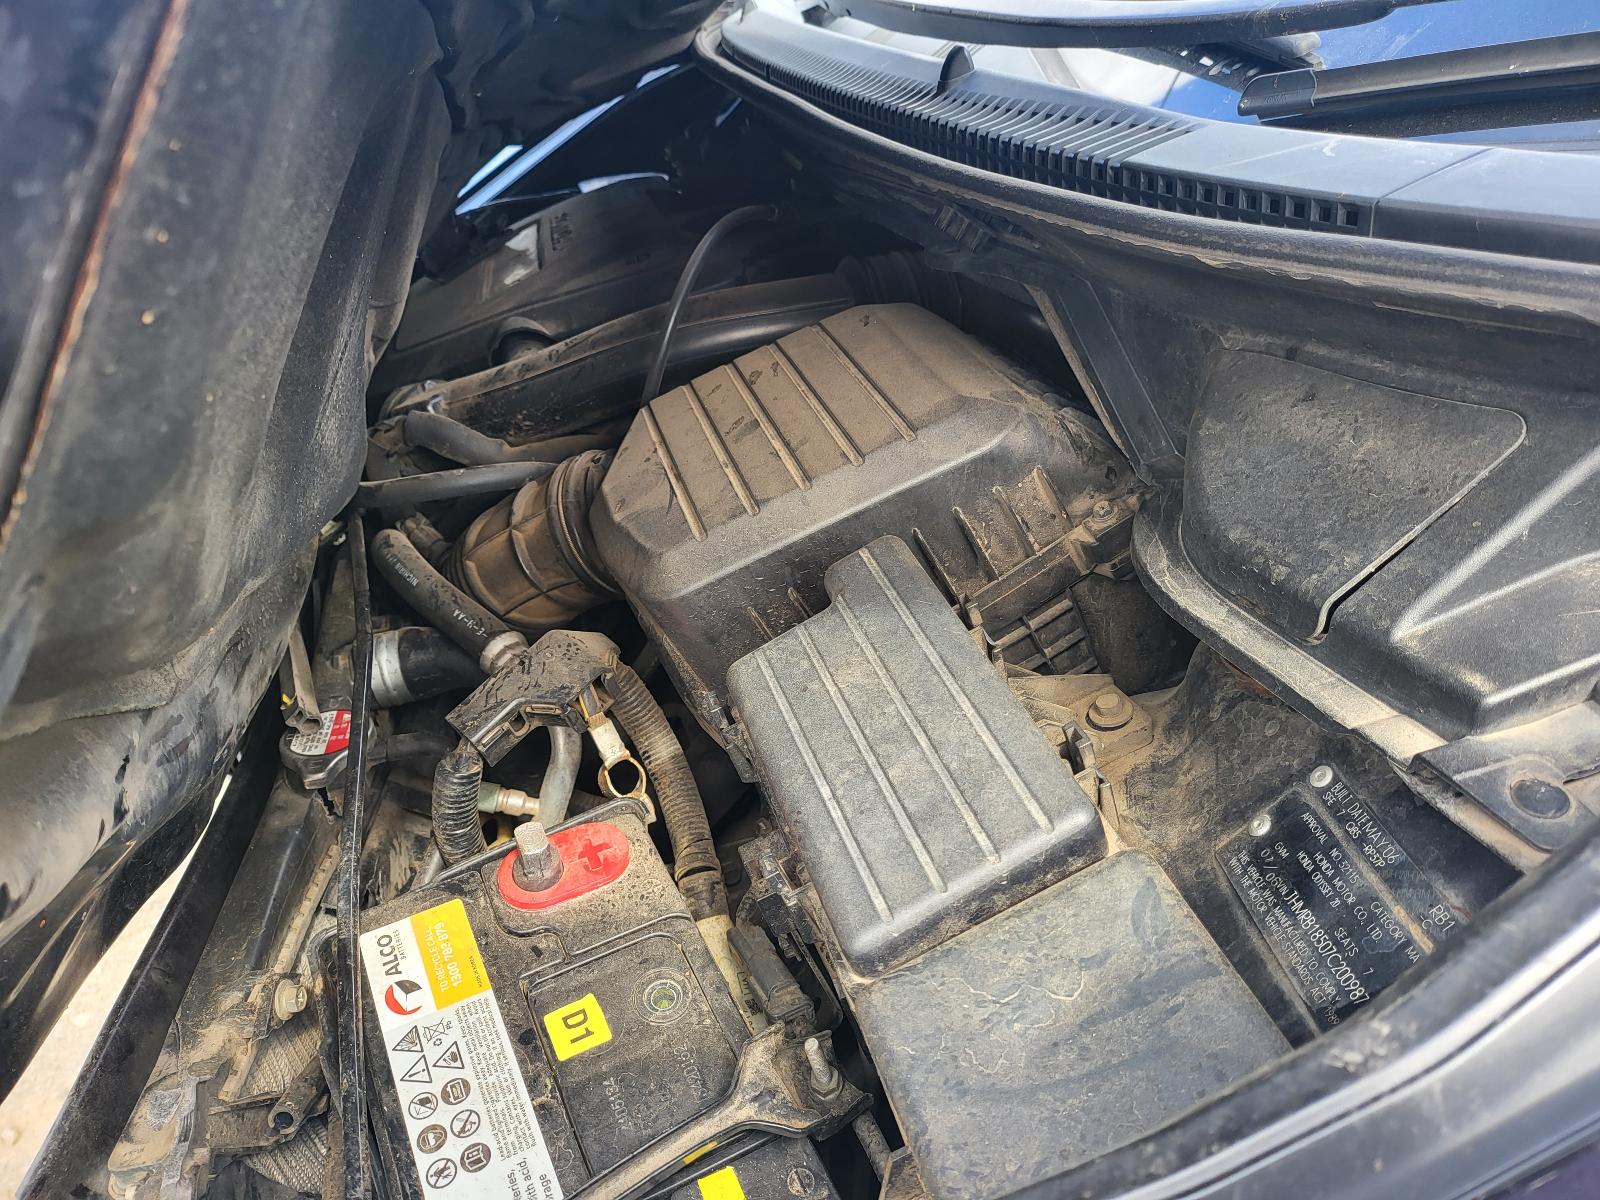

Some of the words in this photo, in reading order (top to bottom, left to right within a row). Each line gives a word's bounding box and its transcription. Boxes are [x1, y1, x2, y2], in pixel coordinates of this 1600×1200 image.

[1330, 781, 1353, 805] BUILT
[1346, 802, 1369, 826] DATE
[1273, 840, 1290, 859] GVM
[1295, 850, 1315, 873] HONDA
[1310, 870, 1334, 898] ODYSSEY
[1300, 810, 1330, 845] APPROVAL
[1368, 900, 1407, 945] CATEGORY
[1404, 946, 1421, 963] MA
[1312, 851, 1335, 877] HONDA
[1331, 876, 1356, 905] MOTOR
[1365, 922, 1384, 943] LTD.
[1427, 903, 1455, 932] RB1
[392, 929, 406, 959] BATTERIES
[1227, 855, 1244, 875] WITH
[1239, 874, 1252, 888] THE
[1247, 887, 1268, 914] MOTOR
[1263, 912, 1286, 942] VEHICLE
[1281, 942, 1313, 985] STANDARDS
[1309, 985, 1326, 1005] ACT
[1236, 850, 1249, 865] THIS
[1245, 863, 1266, 890] VEHICLE
[1261, 888, 1276, 907] WAS
[1272, 905, 1309, 957] MANUFACTURED
[1305, 957, 1319, 971] TO
[1314, 971, 1340, 1004] COMPLY
[1275, 880, 1289, 895] VIN
[1283, 889, 1369, 1007] JHMRB18507C200987
[375, 932, 402, 977] ALCO
[428, 945, 446, 979] RECYCLE
[445, 961, 463, 986] 1300
[1332, 926, 1359, 957] SEATS
[1362, 967, 1373, 977] 7
[560, 1007, 595, 1044] D1
[515, 1156, 533, 1182] acid,
